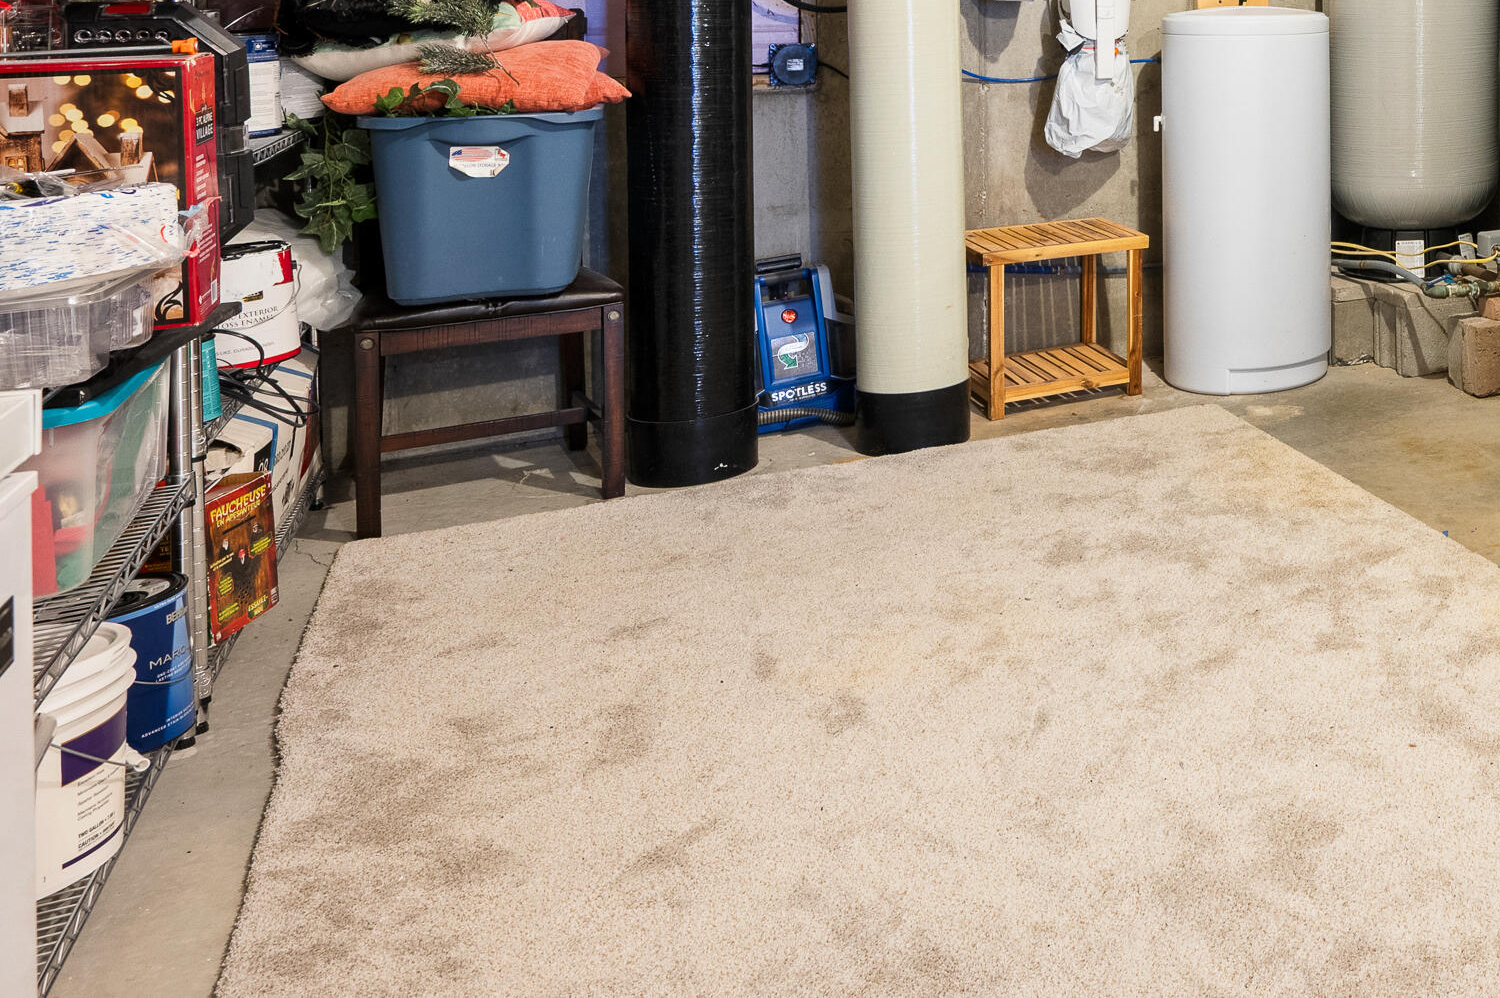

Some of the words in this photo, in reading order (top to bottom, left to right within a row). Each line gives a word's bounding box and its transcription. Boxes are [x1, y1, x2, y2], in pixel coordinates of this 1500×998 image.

[238, 305, 279, 320] EXTERIOR
[771, 382, 828, 402] SPOTLESS
[209, 483, 267, 523] FAUCHEUSE
[216, 518, 225, 528] EN
